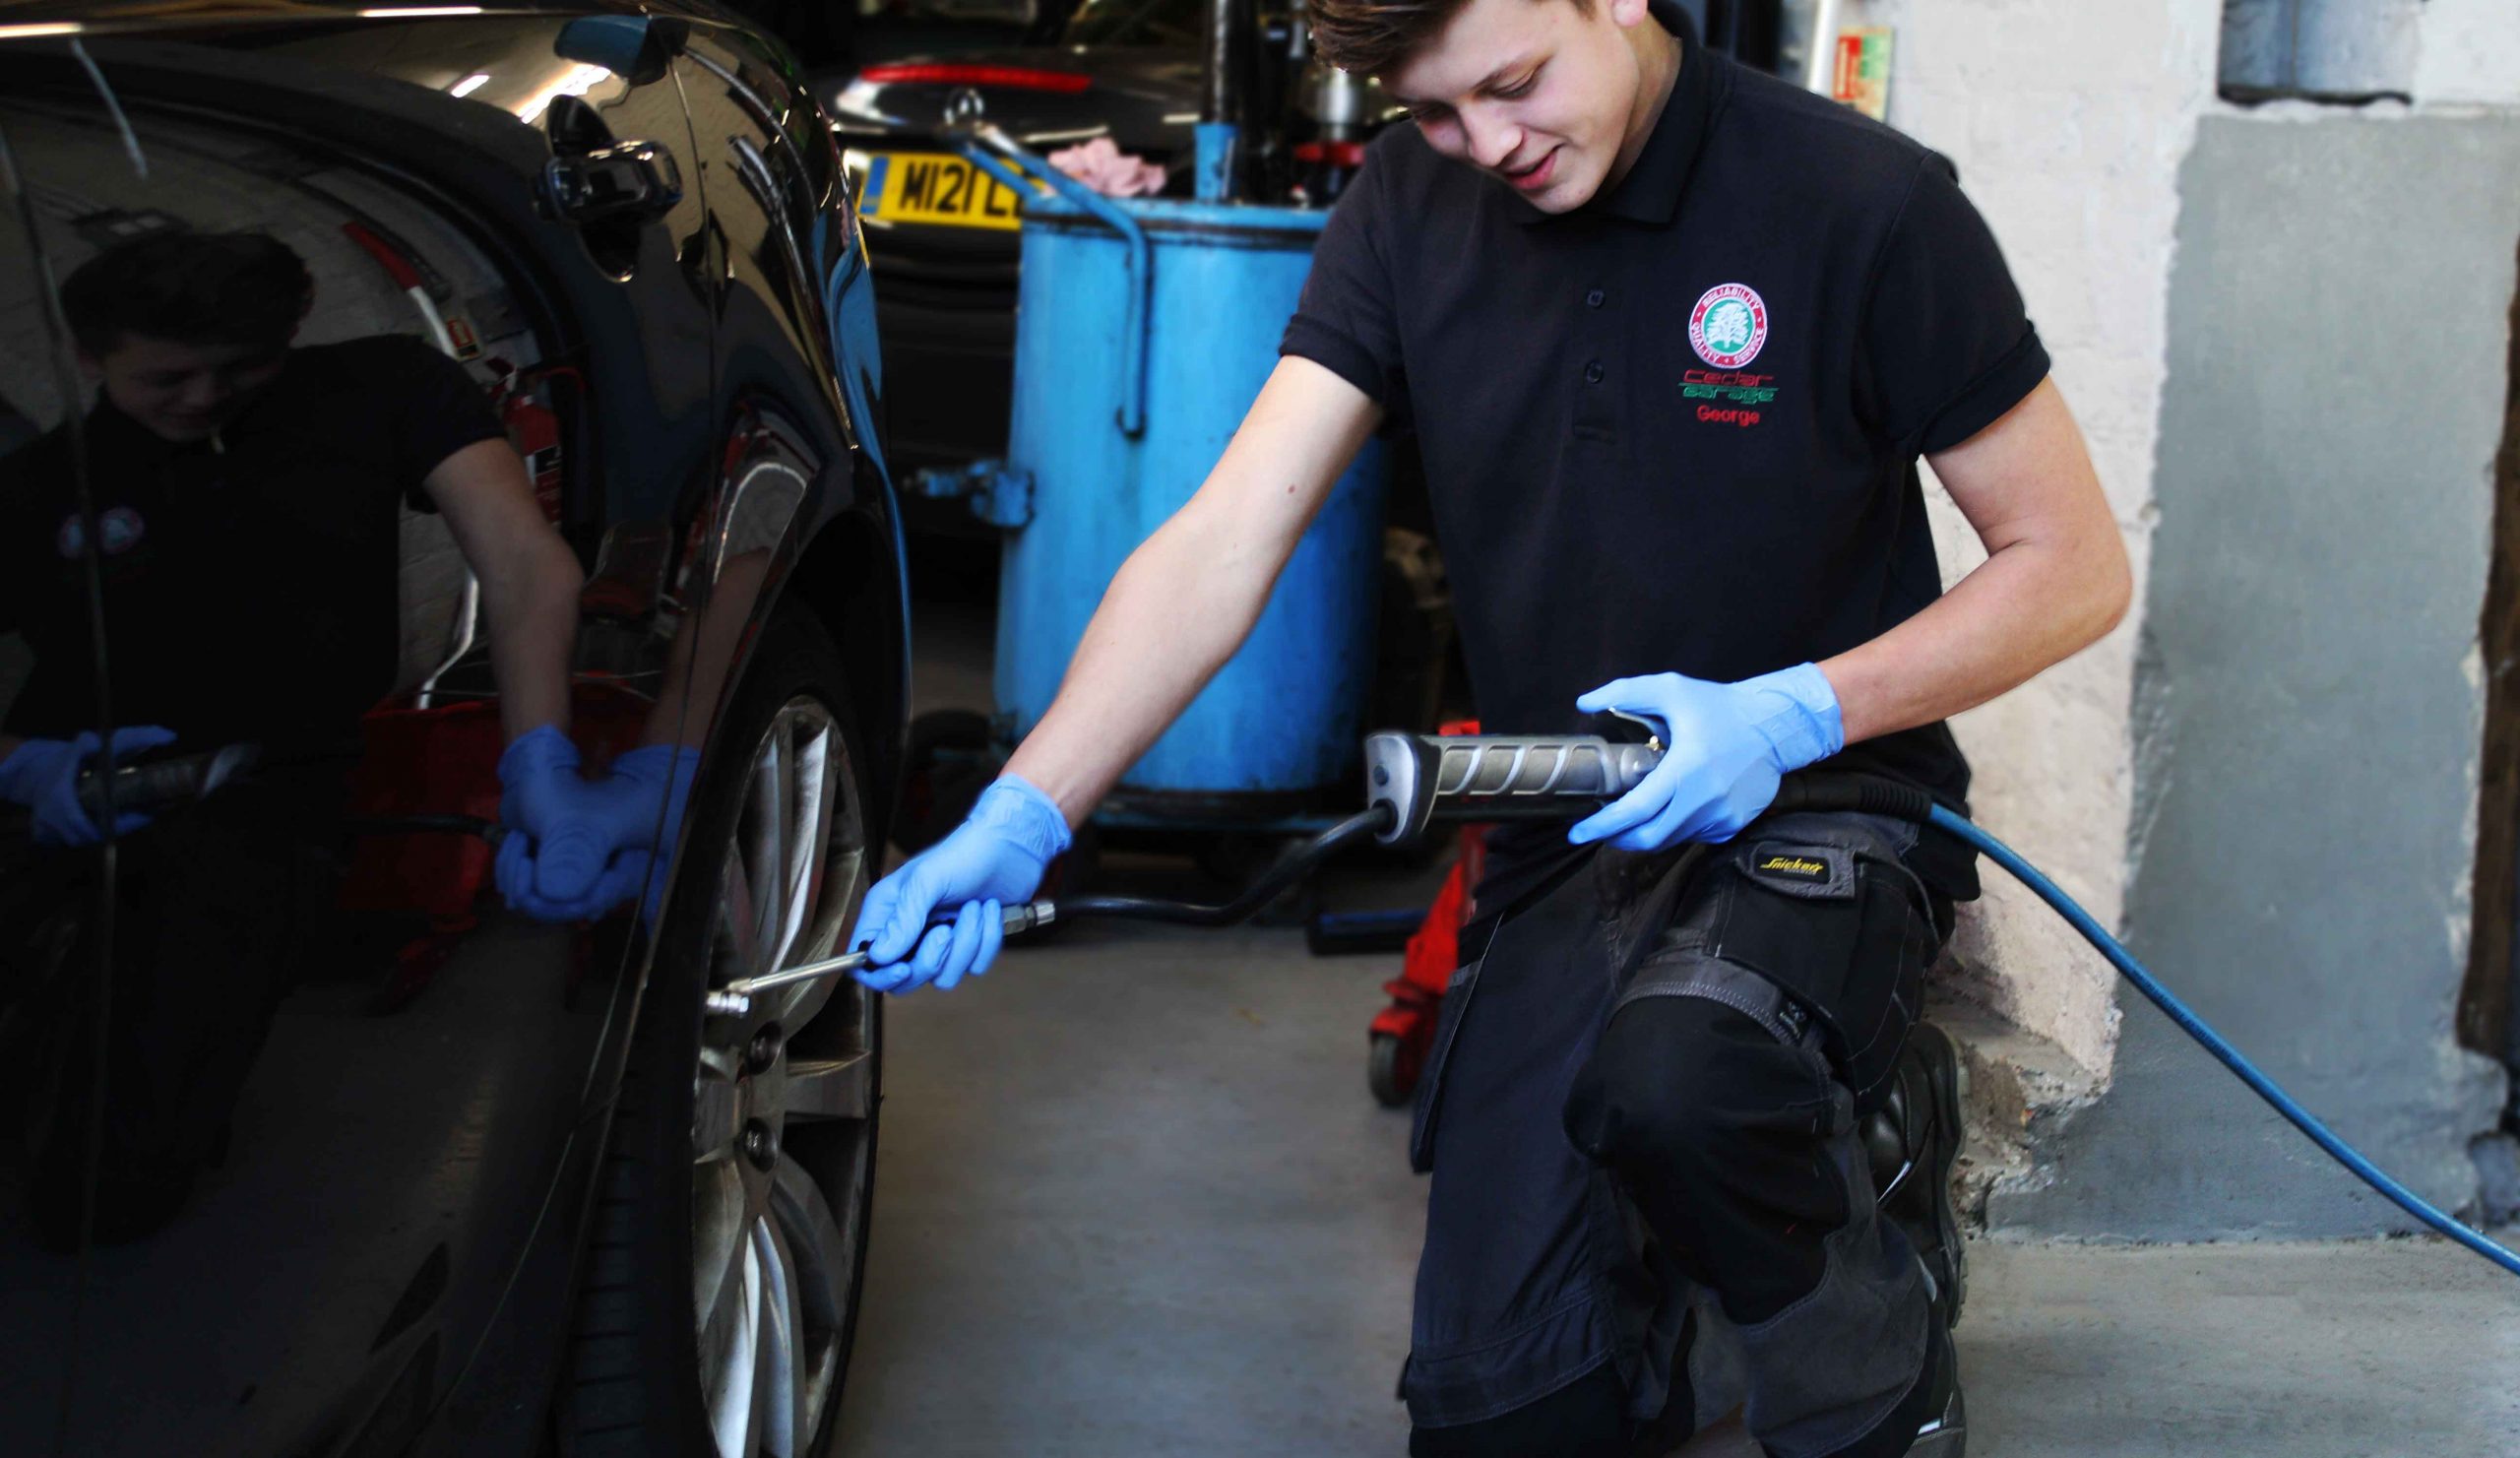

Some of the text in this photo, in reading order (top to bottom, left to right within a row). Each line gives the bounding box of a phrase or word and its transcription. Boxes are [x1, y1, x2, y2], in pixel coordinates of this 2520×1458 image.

[1702, 285, 1760, 310] RELIABILITY
[1691, 321, 1722, 363] QUALITY
[1732, 327, 1764, 365] SERVICE
[1697, 405, 1760, 426] George
